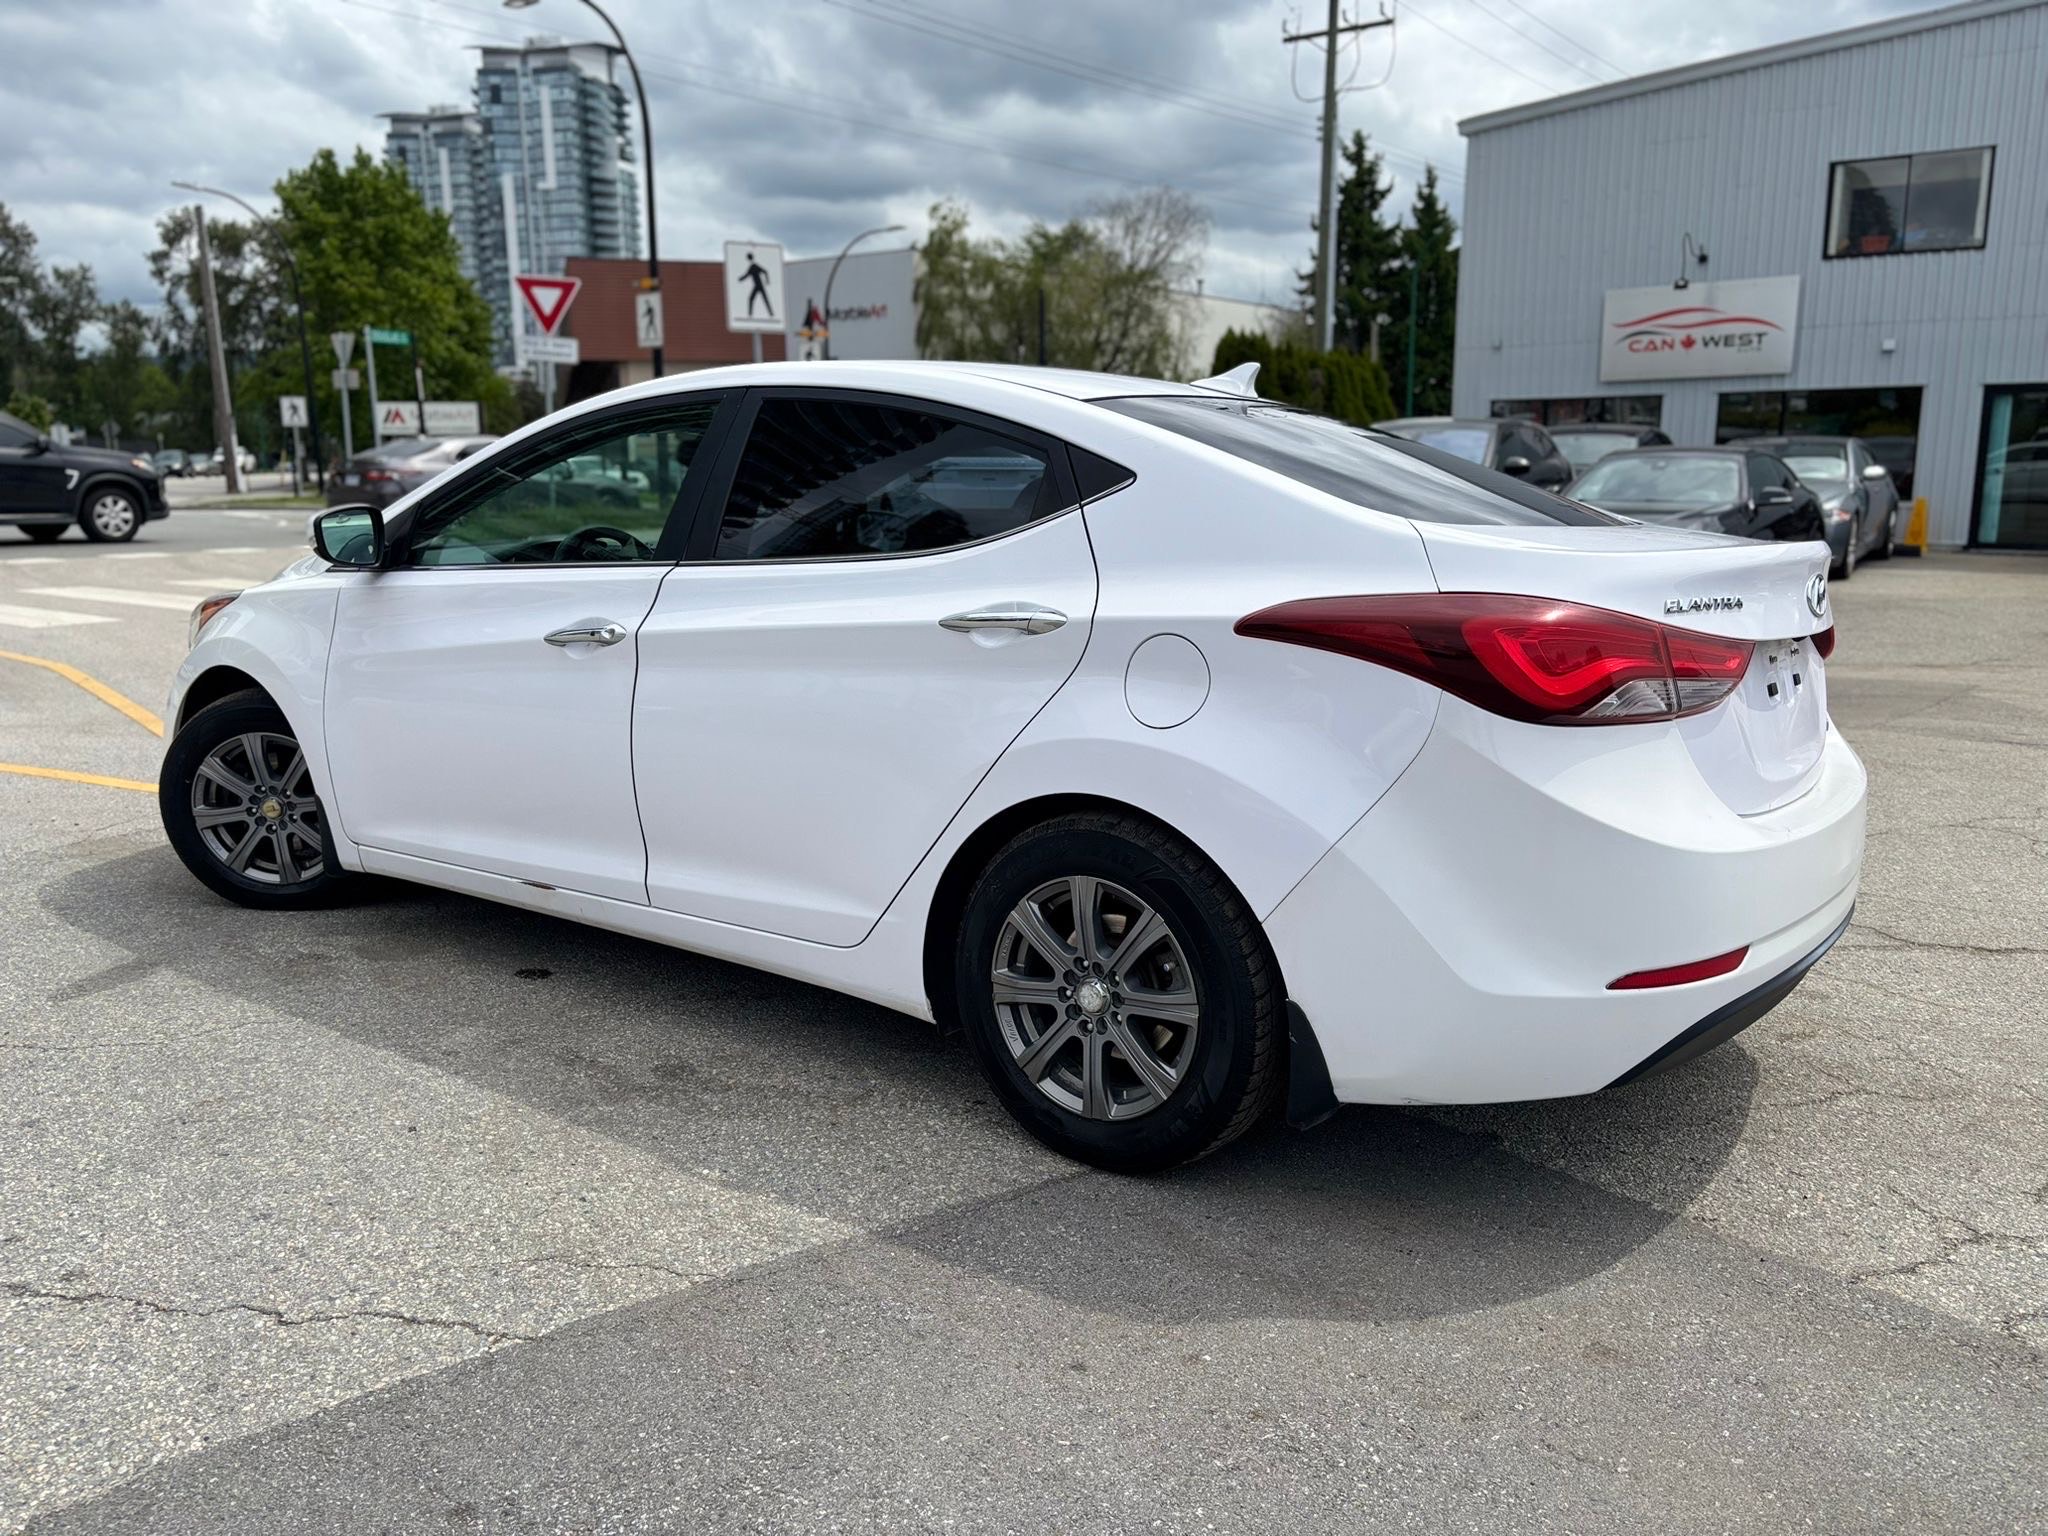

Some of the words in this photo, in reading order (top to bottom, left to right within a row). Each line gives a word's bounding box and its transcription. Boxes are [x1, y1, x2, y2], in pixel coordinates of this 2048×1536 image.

[1628, 338, 1675, 353] CAN
[1702, 332, 1769, 348] WEST
[1664, 595, 1744, 615] ELANTRA
